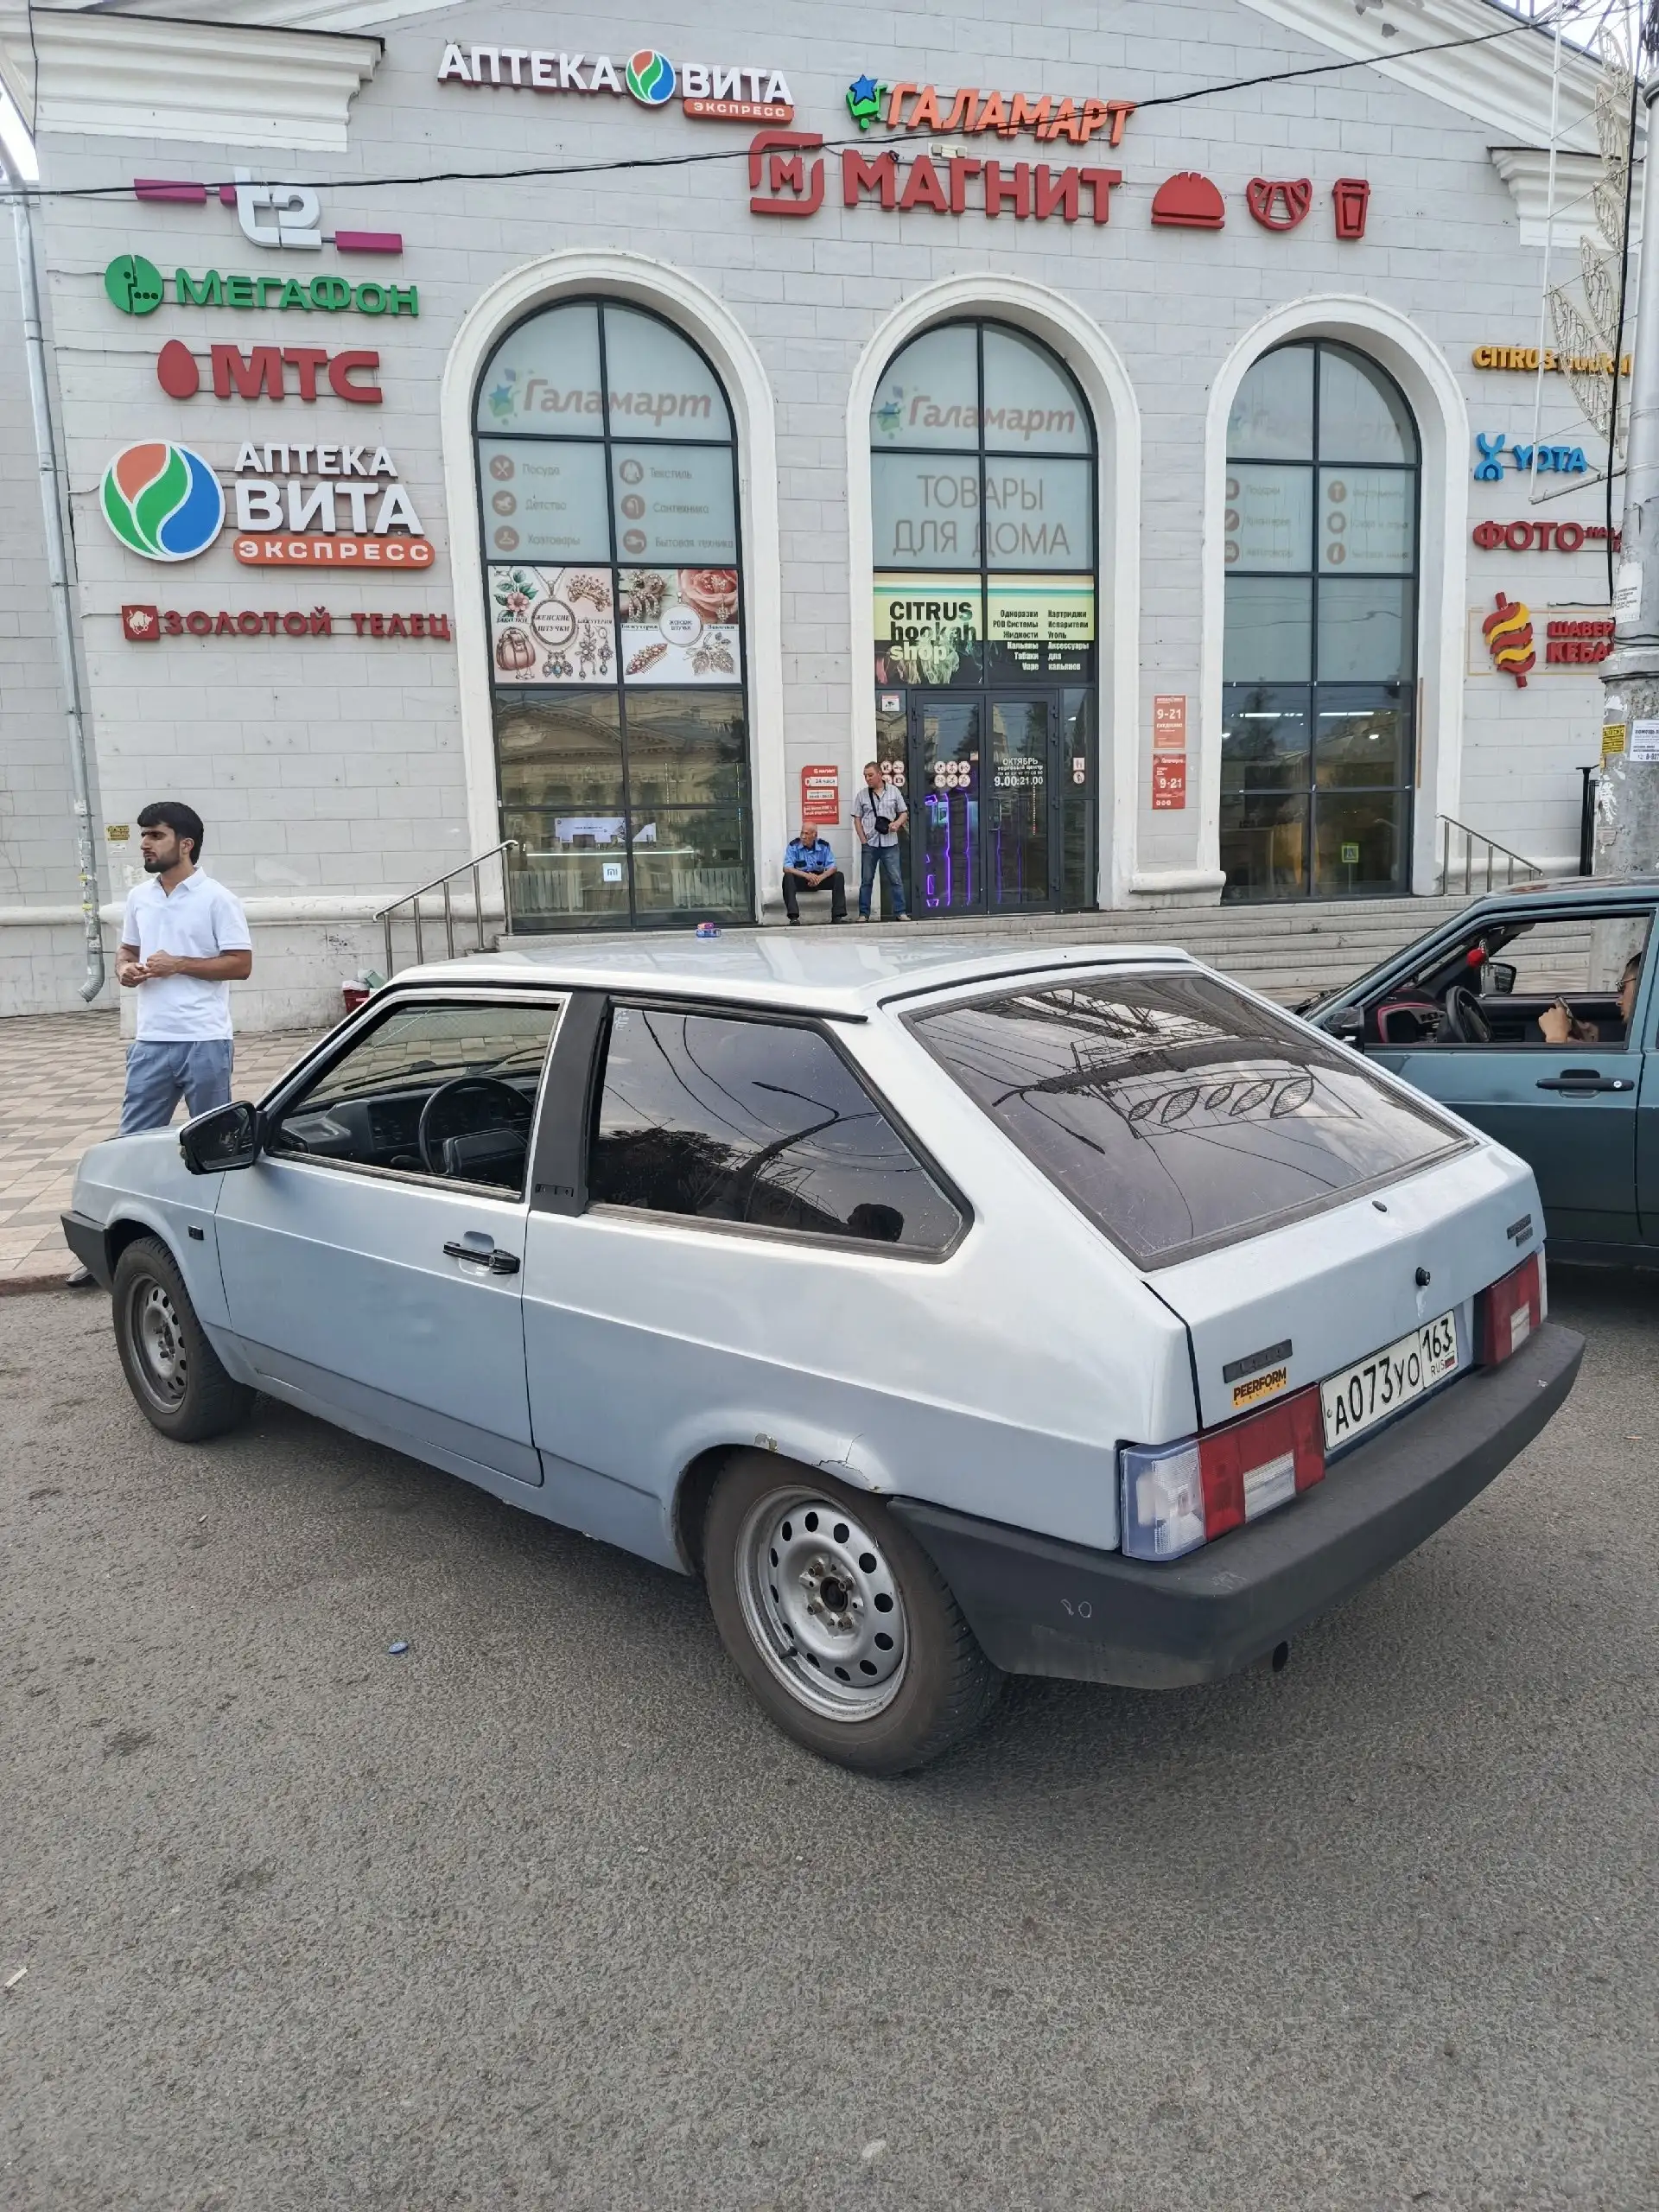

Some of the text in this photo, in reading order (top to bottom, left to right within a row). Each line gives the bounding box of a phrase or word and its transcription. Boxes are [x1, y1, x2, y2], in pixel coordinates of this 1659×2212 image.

[438, 43, 794, 105] АПТЕКА ВИТА
[694, 102, 785, 117] ЭКСПРЕСС
[886, 82, 1138, 147] ГАЛАМАРТ
[842, 149, 1122, 224] МАГНИТ
[211, 345, 383, 404] МТС
[1472, 346, 1556, 370] CITRUS
[523, 378, 712, 428] Галамарт
[908, 396, 1075, 441] Галамарт
[234, 442, 398, 478] АПТЕКА
[1513, 444, 1588, 473] YOTA
[235, 479, 425, 536] ВИТА
[917, 474, 1043, 512] ТОВАРЫ
[238, 540, 429, 561] ЭКСПРЕСС
[893, 520, 1071, 558] ДЛЯ ДОМА
[1472, 521, 1585, 551] ФОТО
[164, 606, 451, 641] ЗОЛОТОЙ ТЕЛЕЦ
[889, 601, 973, 621] CITRUS
[1000, 609, 1039, 618] Одноразки
[1548, 620, 1615, 638] ШАВЕР
[889, 642, 947, 664] shop
[1002, 757, 1039, 766] ОКТЯБРЬ
[1422, 1319, 1453, 1363] 163
[1233, 1367, 1287, 1401] PEERFORM
[1431, 1359, 1445, 1377] RUS
